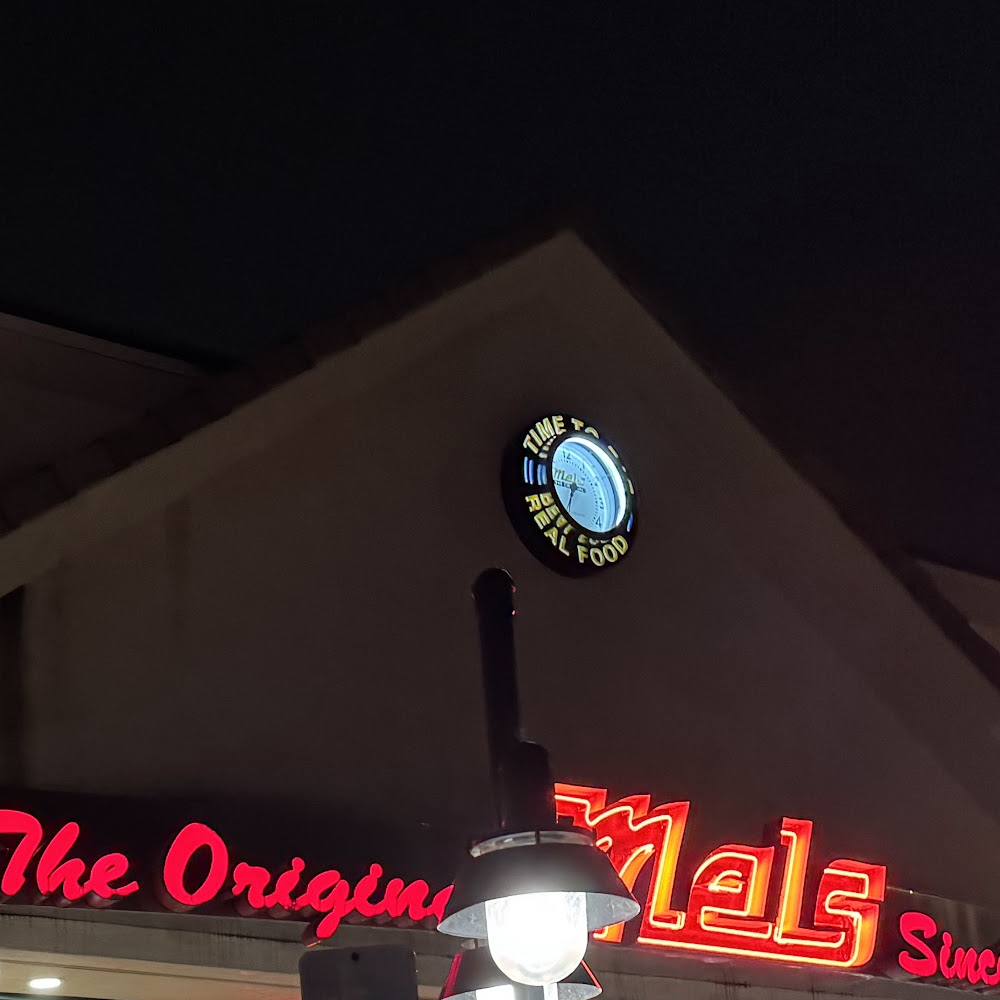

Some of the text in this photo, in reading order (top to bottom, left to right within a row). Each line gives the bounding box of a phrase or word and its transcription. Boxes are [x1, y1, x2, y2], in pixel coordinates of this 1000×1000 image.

[523, 415, 566, 454] TIME
[525, 496, 629, 566] REAL FOOD
[163, 822, 454, 938] Origin
[554, 783, 887, 968] Mels
[899, 911, 1000, 986] Sinc
